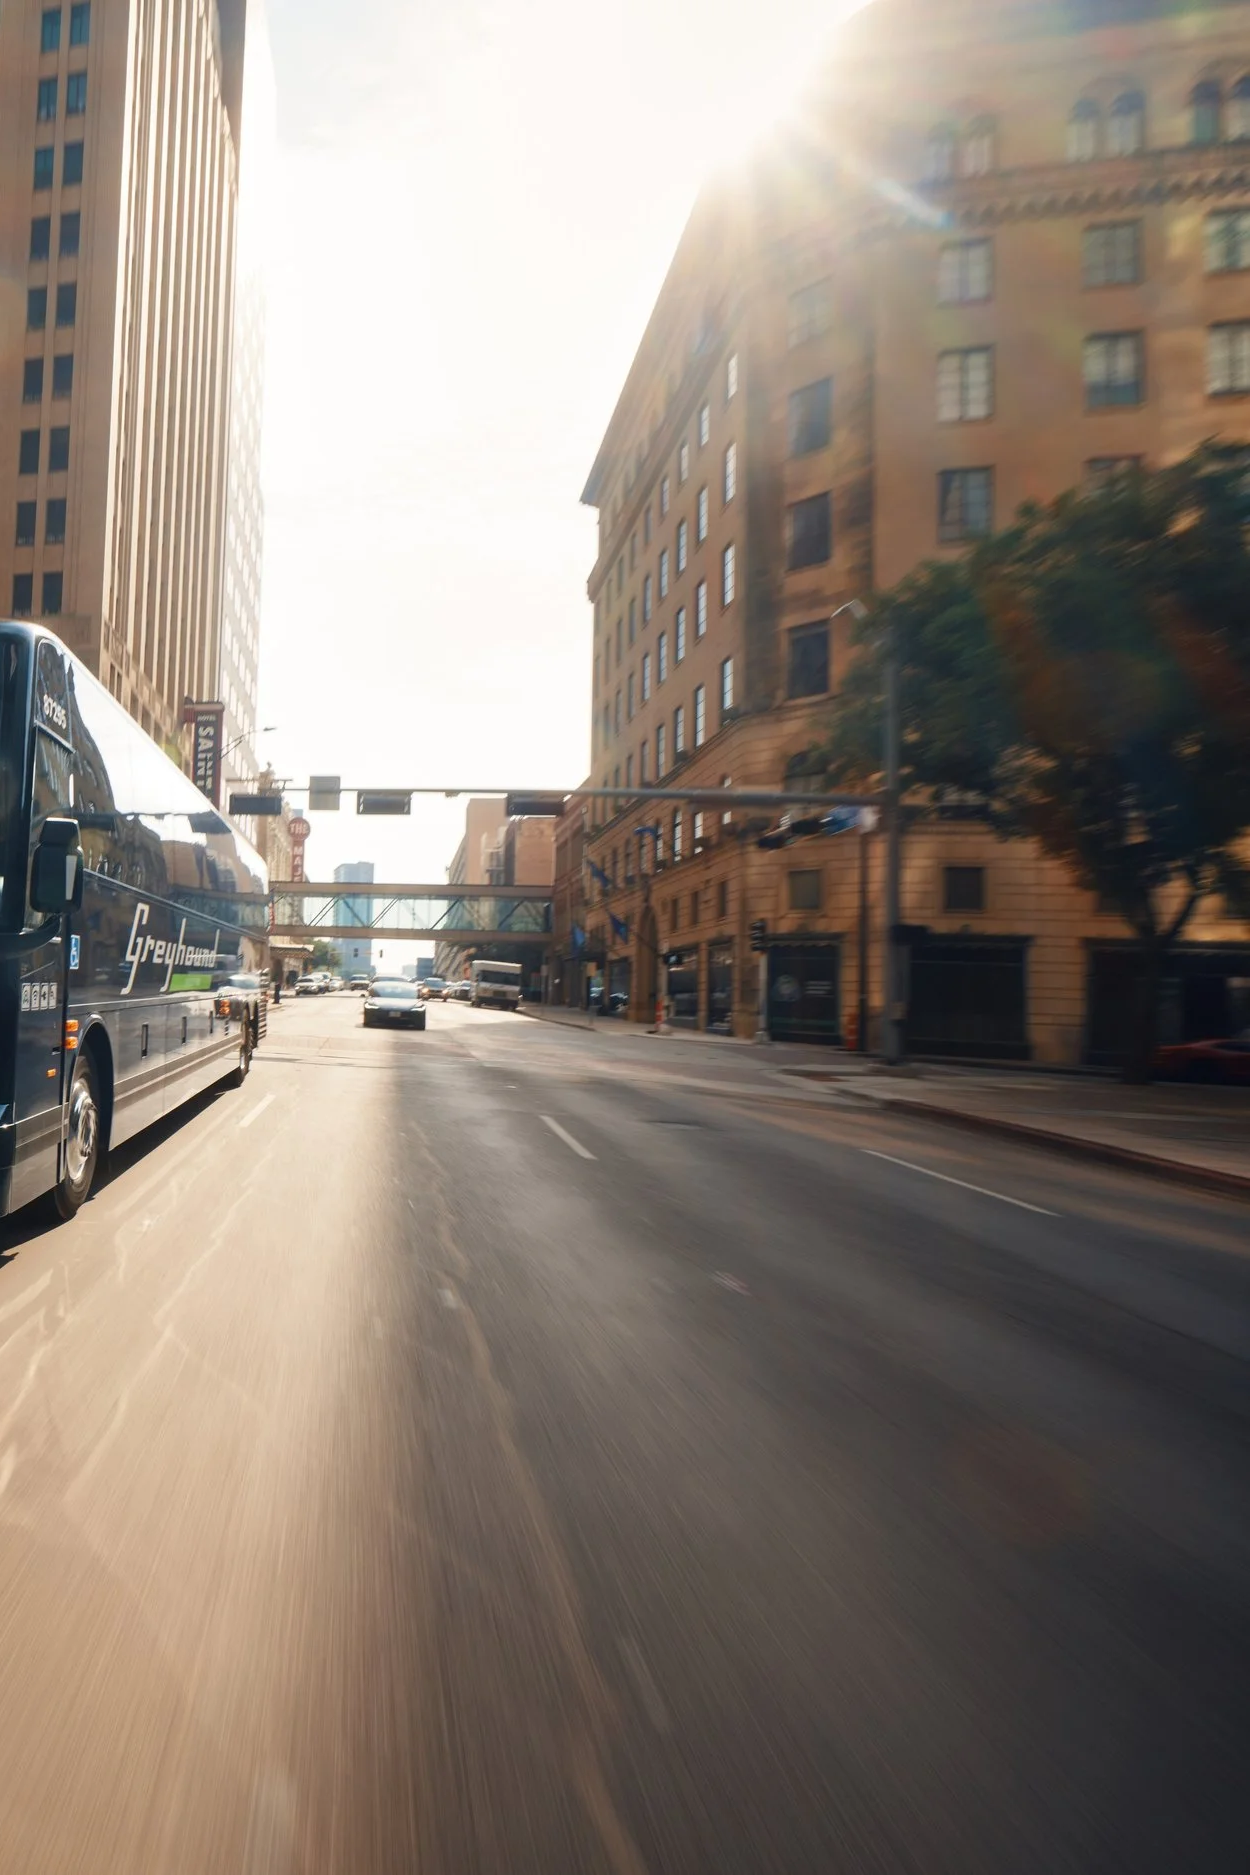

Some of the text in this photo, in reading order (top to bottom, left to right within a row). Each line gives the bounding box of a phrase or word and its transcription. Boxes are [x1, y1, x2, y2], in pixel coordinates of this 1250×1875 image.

[196, 725, 215, 790] SAINT
[290, 822, 308, 835] THE
[120, 902, 220, 995] Greyhound
